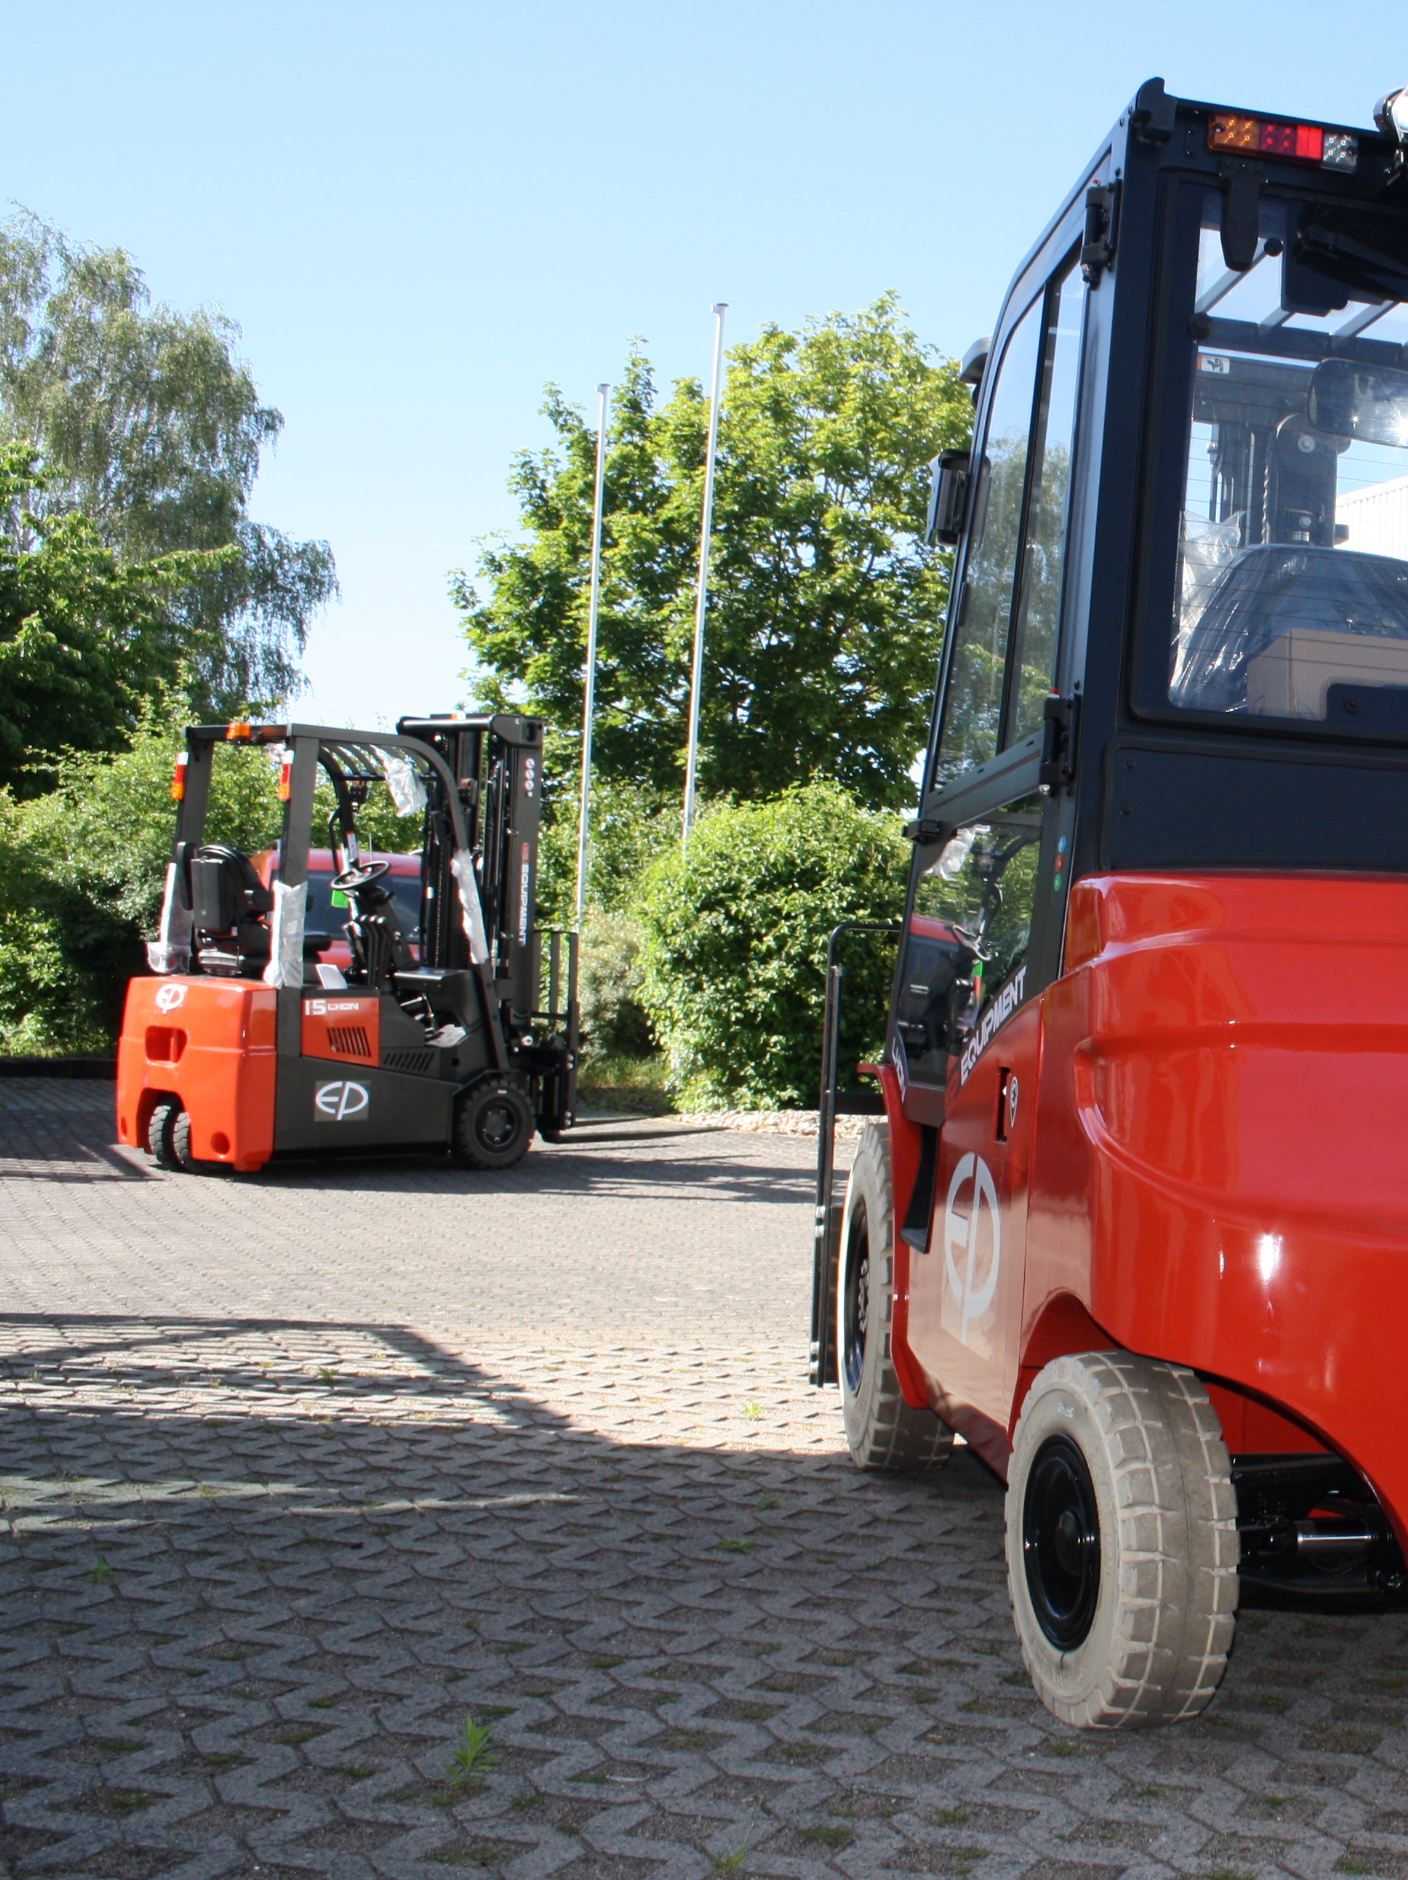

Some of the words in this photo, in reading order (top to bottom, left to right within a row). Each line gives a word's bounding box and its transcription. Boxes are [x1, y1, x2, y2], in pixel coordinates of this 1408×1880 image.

[519, 863, 530, 946] EQUIPMENT
[156, 983, 186, 1014] EP
[961, 965, 1027, 1085] EQUIPMENT
[315, 1081, 369, 1120] EP
[944, 1152, 1001, 1344] EP
